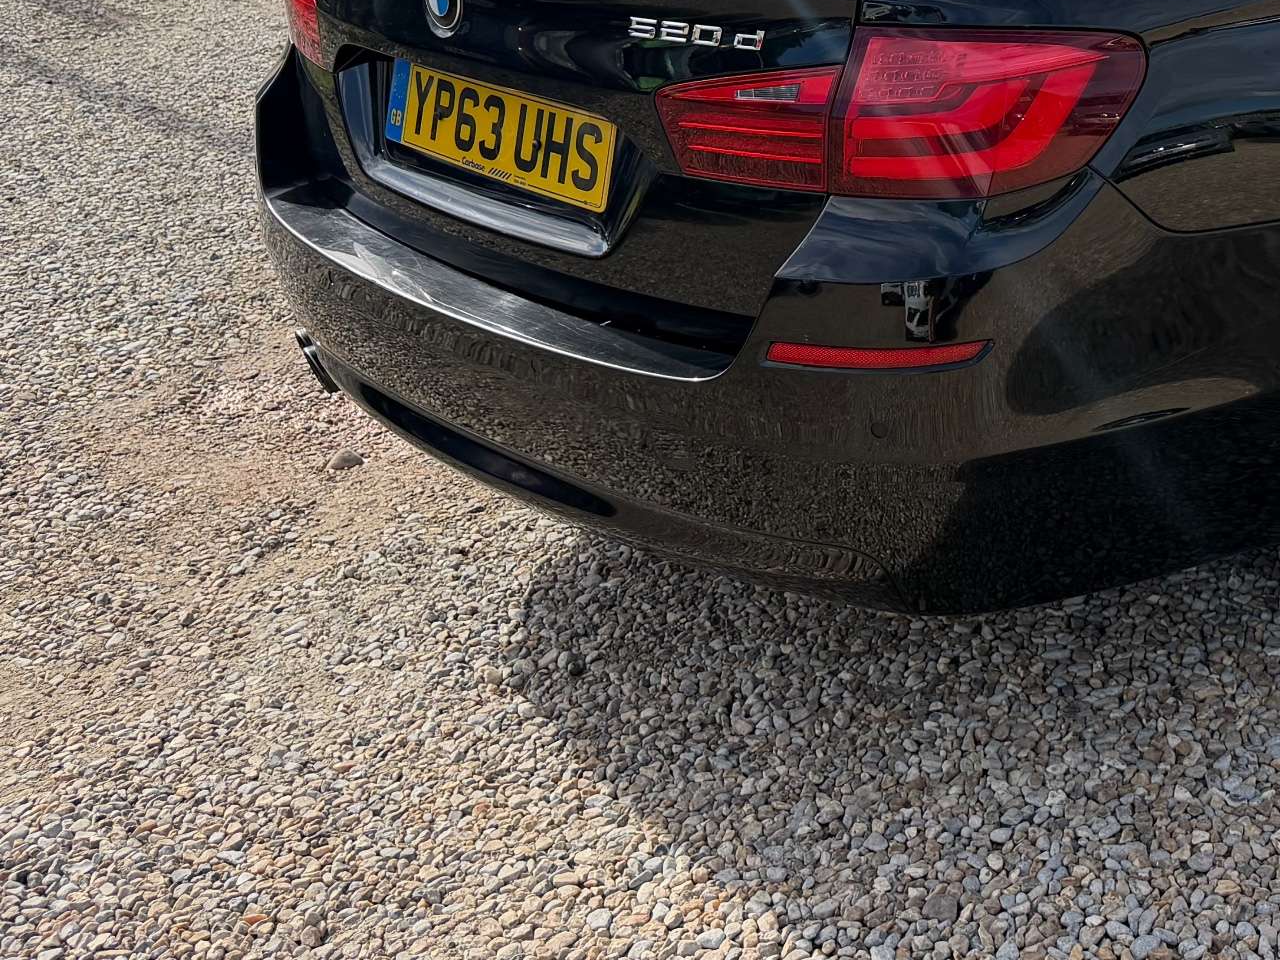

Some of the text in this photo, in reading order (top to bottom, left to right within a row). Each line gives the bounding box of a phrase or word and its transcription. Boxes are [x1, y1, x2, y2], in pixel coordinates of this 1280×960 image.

[390, 109, 402, 127] GB
[414, 71, 604, 191] YP63 UHS
